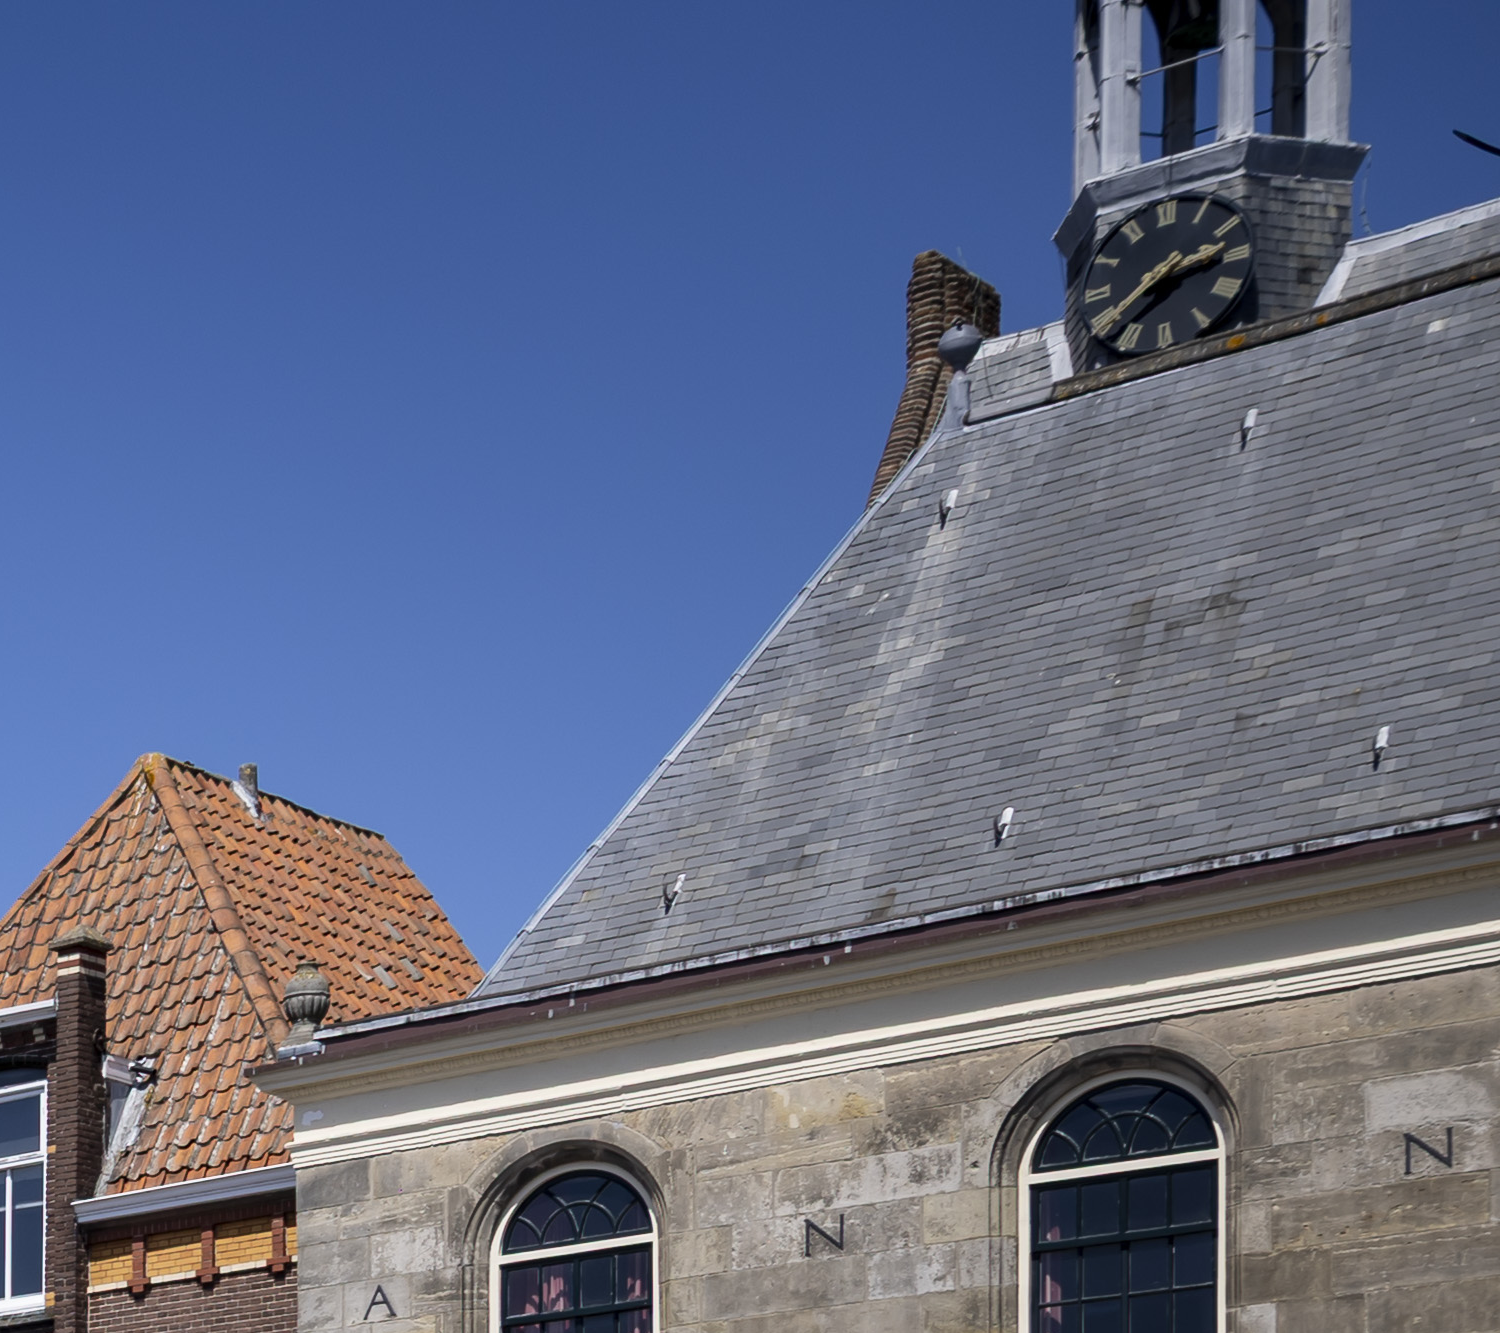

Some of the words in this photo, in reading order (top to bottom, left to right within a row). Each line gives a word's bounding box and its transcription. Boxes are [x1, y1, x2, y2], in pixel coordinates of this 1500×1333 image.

[364, 1284, 396, 1319] A
[805, 1215, 845, 1257] N
[1404, 1127, 1454, 1176] N
